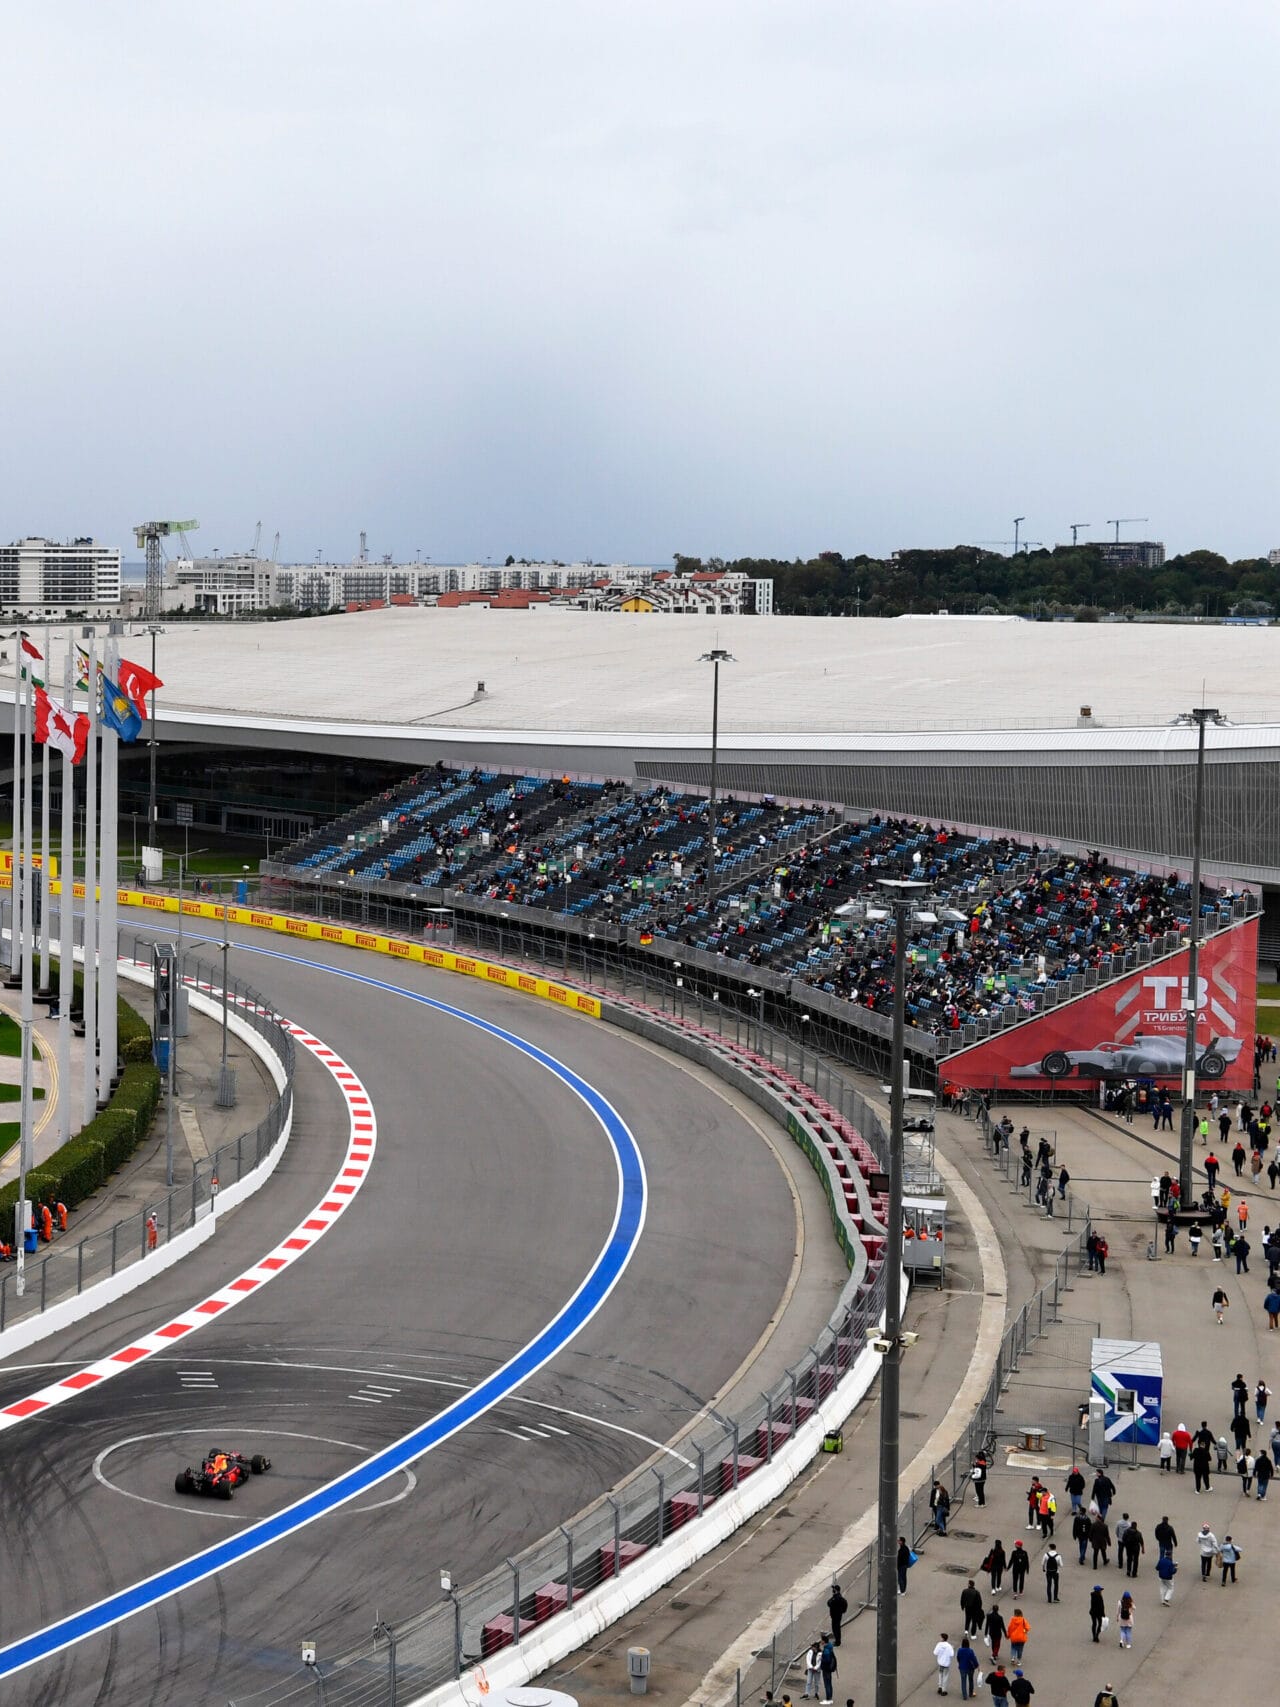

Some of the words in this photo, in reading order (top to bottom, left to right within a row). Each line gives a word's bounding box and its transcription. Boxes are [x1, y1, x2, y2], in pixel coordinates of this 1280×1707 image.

[142, 895, 164, 907] PIRELLI
[181, 902, 200, 914] IRELLI
[251, 913, 273, 926] PIRELLI
[286, 920, 308, 933] PIRELLI
[321, 927, 343, 940] PIRELLI
[356, 934, 376, 947] PIRELLI
[389, 941, 409, 955] PIRELLI
[423, 950, 443, 964] PIRELLI
[456, 958, 476, 972] PIRELLI
[488, 967, 507, 982] PIRELLI
[518, 976, 536, 991] PIRELLI
[549, 986, 566, 1001] PIRELLI
[578, 997, 595, 1012] PIRELLI
[1144, 1012, 1207, 1022] ТРИБУА
